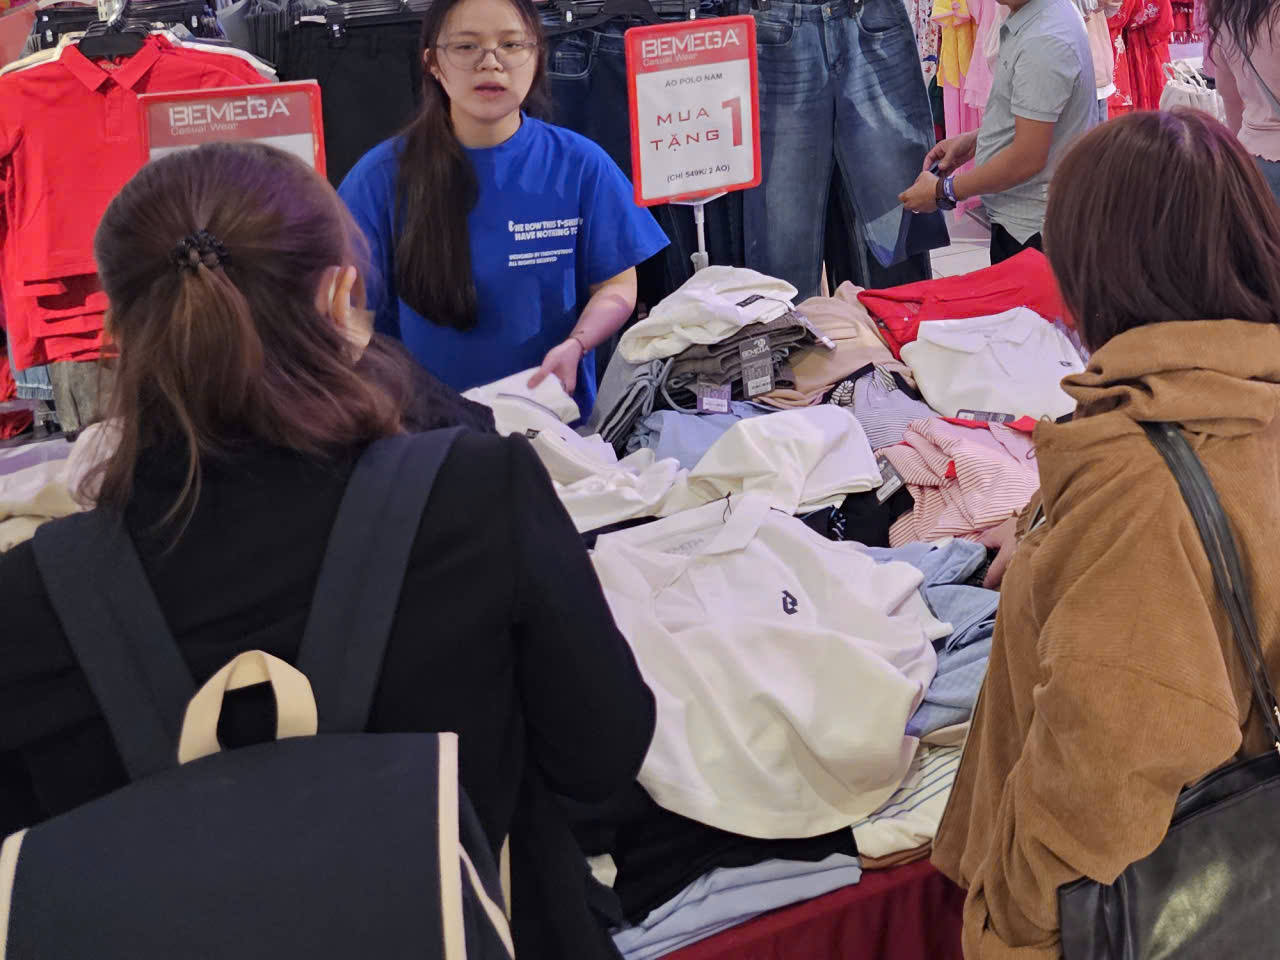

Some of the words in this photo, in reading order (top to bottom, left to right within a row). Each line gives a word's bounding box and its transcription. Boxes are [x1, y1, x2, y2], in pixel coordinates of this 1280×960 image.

[642, 29, 739, 58] BEMEGA
[680, 76, 703, 86] POLO
[704, 73, 723, 81] NAM
[169, 95, 290, 126] BEMEGA
[657, 107, 710, 126] MUA
[171, 124, 206, 136] Casual
[210, 123, 238, 131] Wear
[721, 96, 743, 147] 1
[650, 129, 719, 152] TẶNG
[515, 232, 535, 241] HAVE
[536, 228, 569, 239] NOTHING
